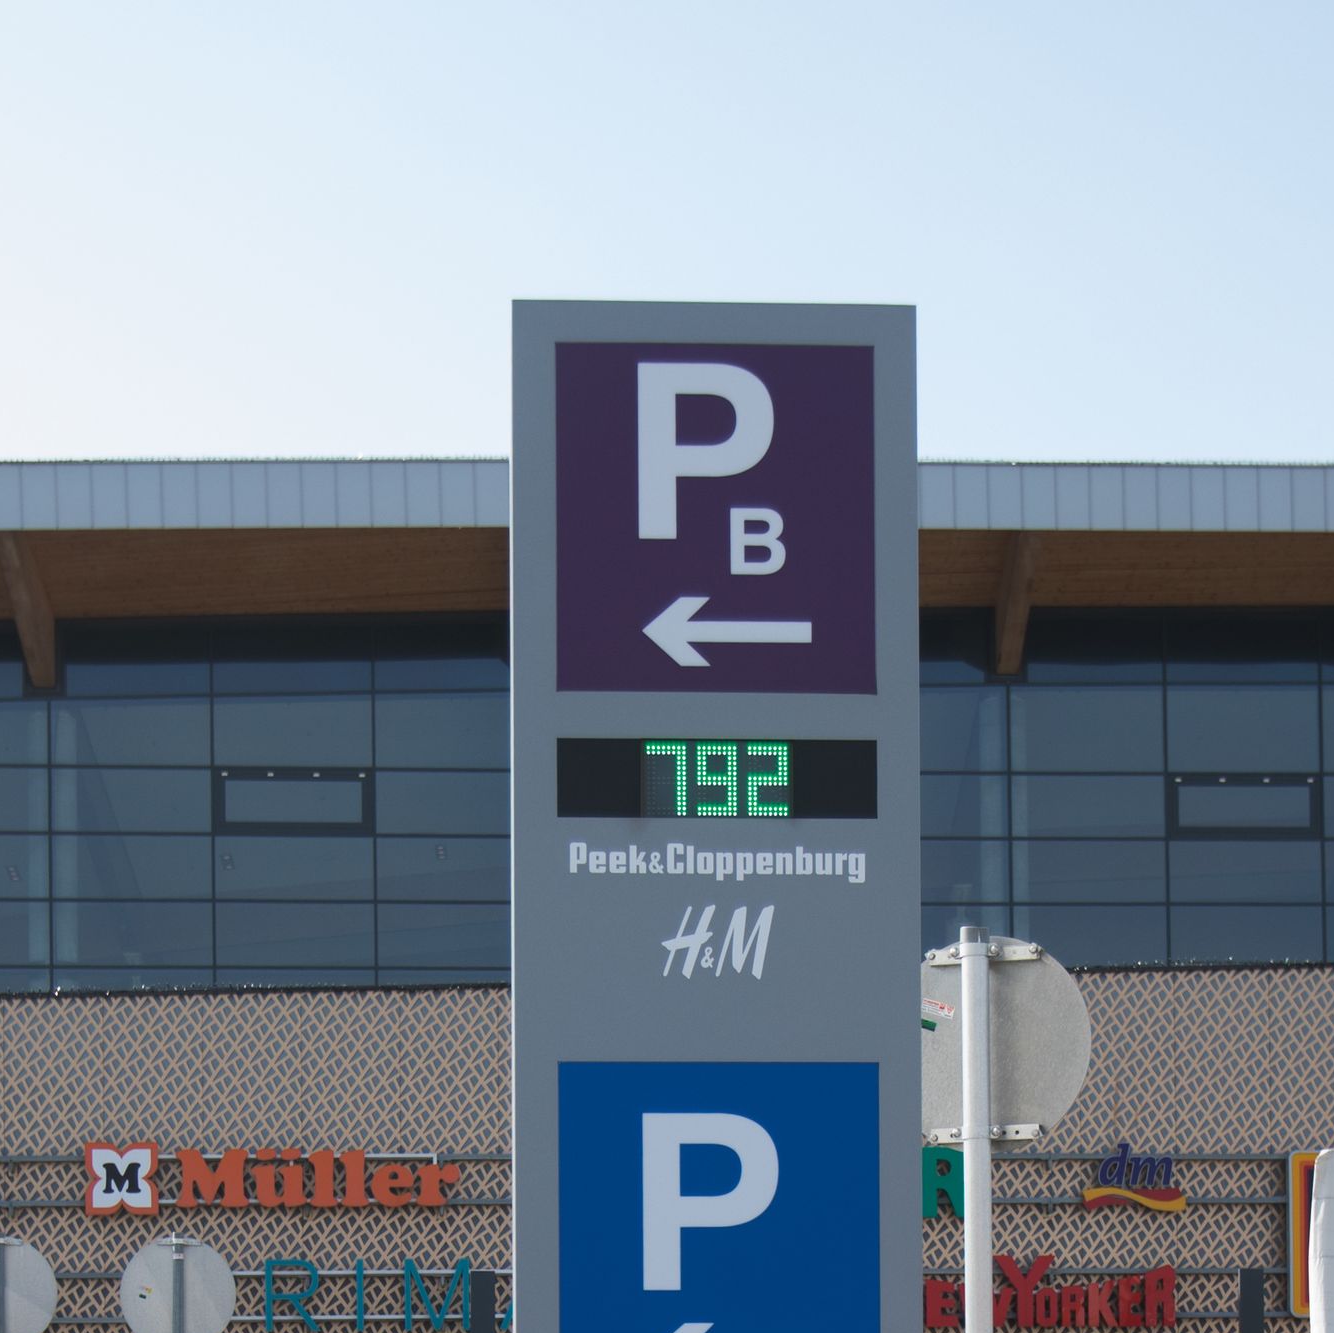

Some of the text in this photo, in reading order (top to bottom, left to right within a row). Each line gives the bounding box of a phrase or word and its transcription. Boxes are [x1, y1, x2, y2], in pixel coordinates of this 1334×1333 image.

[637, 362, 775, 540] P
[730, 507, 787, 576] B
[644, 743, 790, 817] 792
[569, 842, 867, 883] Peek&Cloppenburg
[661, 904, 775, 980] H&M
[101, 1162, 143, 1194] M
[176, 1147, 461, 1208] Müller
[1098, 1143, 1174, 1187] dm
[642, 1112, 779, 1291] P
[265, 1258, 513, 1332] RIM
